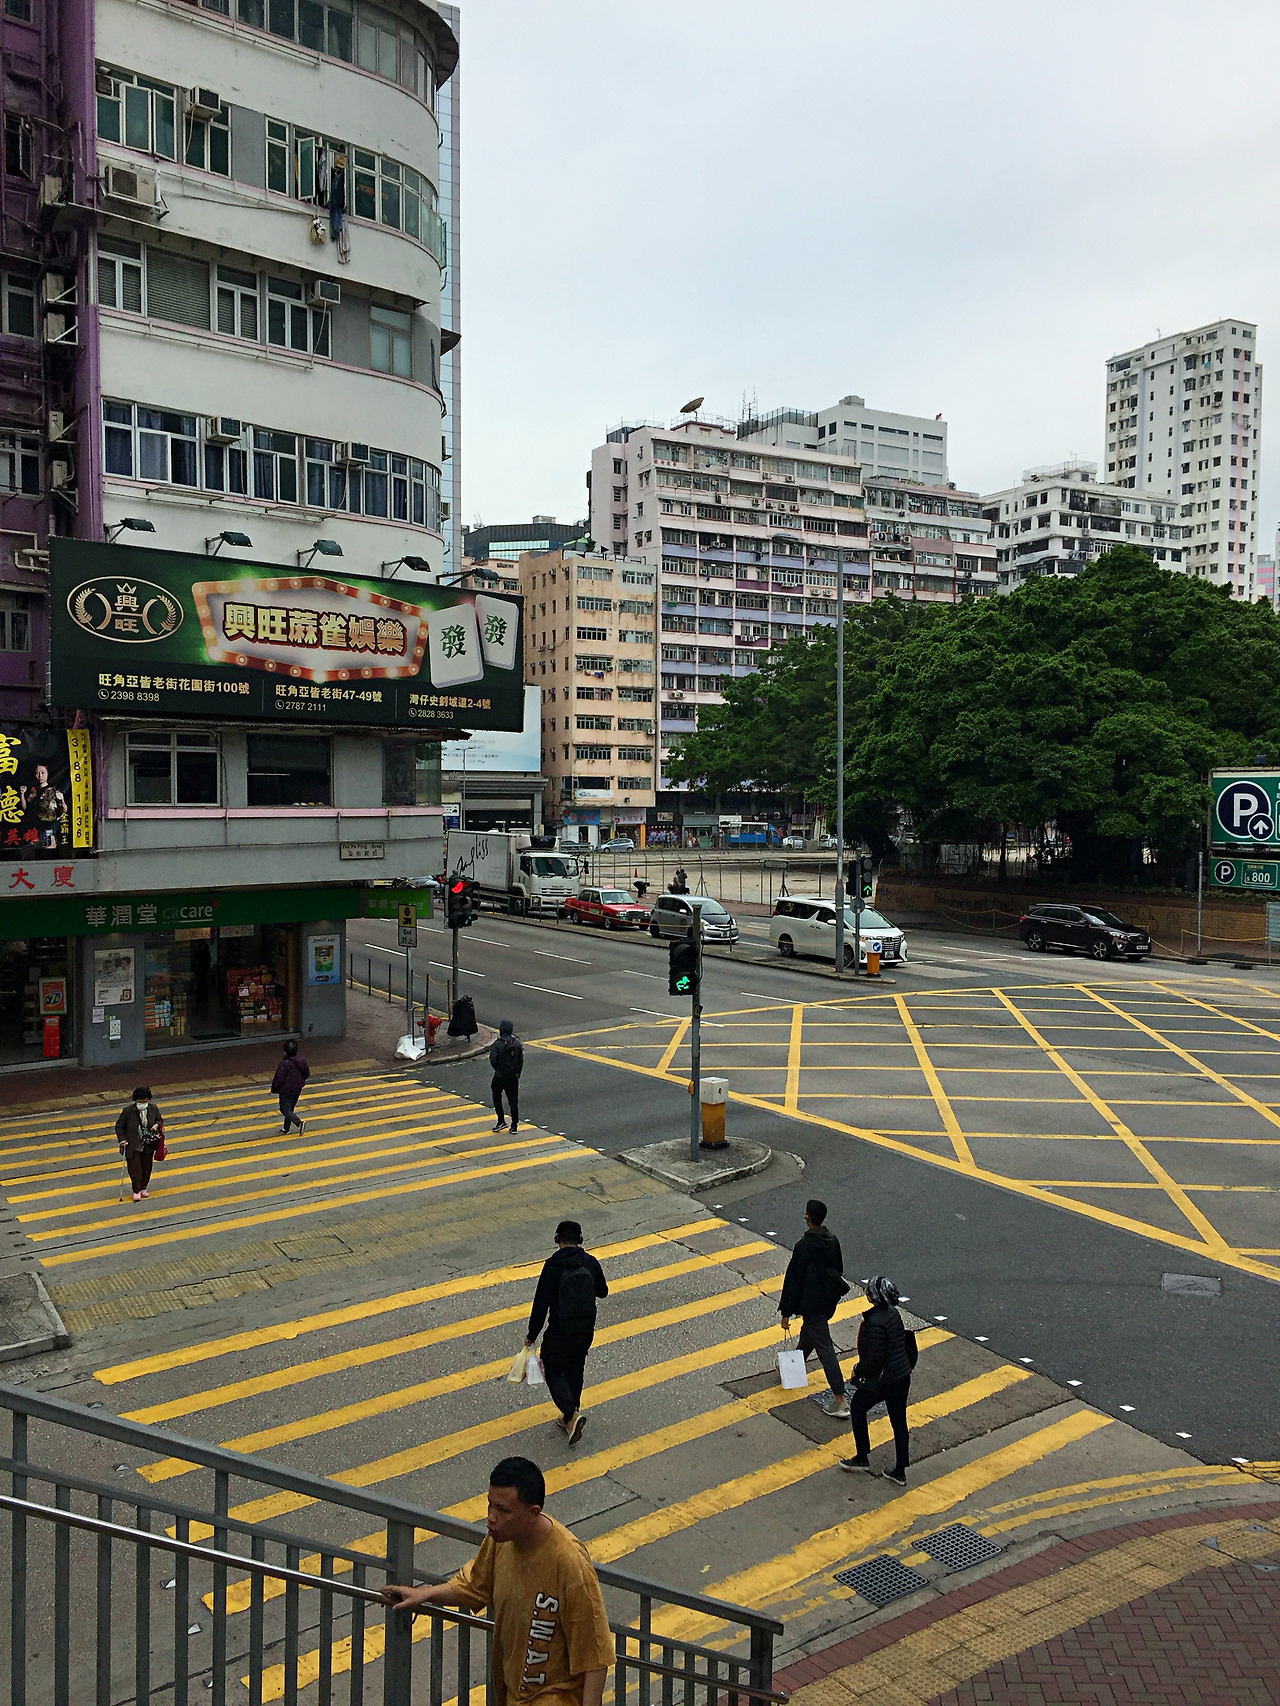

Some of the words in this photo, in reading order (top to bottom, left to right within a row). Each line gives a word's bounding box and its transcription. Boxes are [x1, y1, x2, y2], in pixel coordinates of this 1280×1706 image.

[483, 614, 508, 647] 發
[440, 623, 467, 659] 發
[110, 691, 134, 700] 2398
[136, 692, 160, 702] 8398
[285, 701, 305, 710] 2787
[307, 702, 327, 712] 2111
[417, 709, 435, 718] 2828
[1233, 793, 1259, 827] P
[1220, 865, 1231, 880] P
[85, 903, 157, 928] 華潤堂
